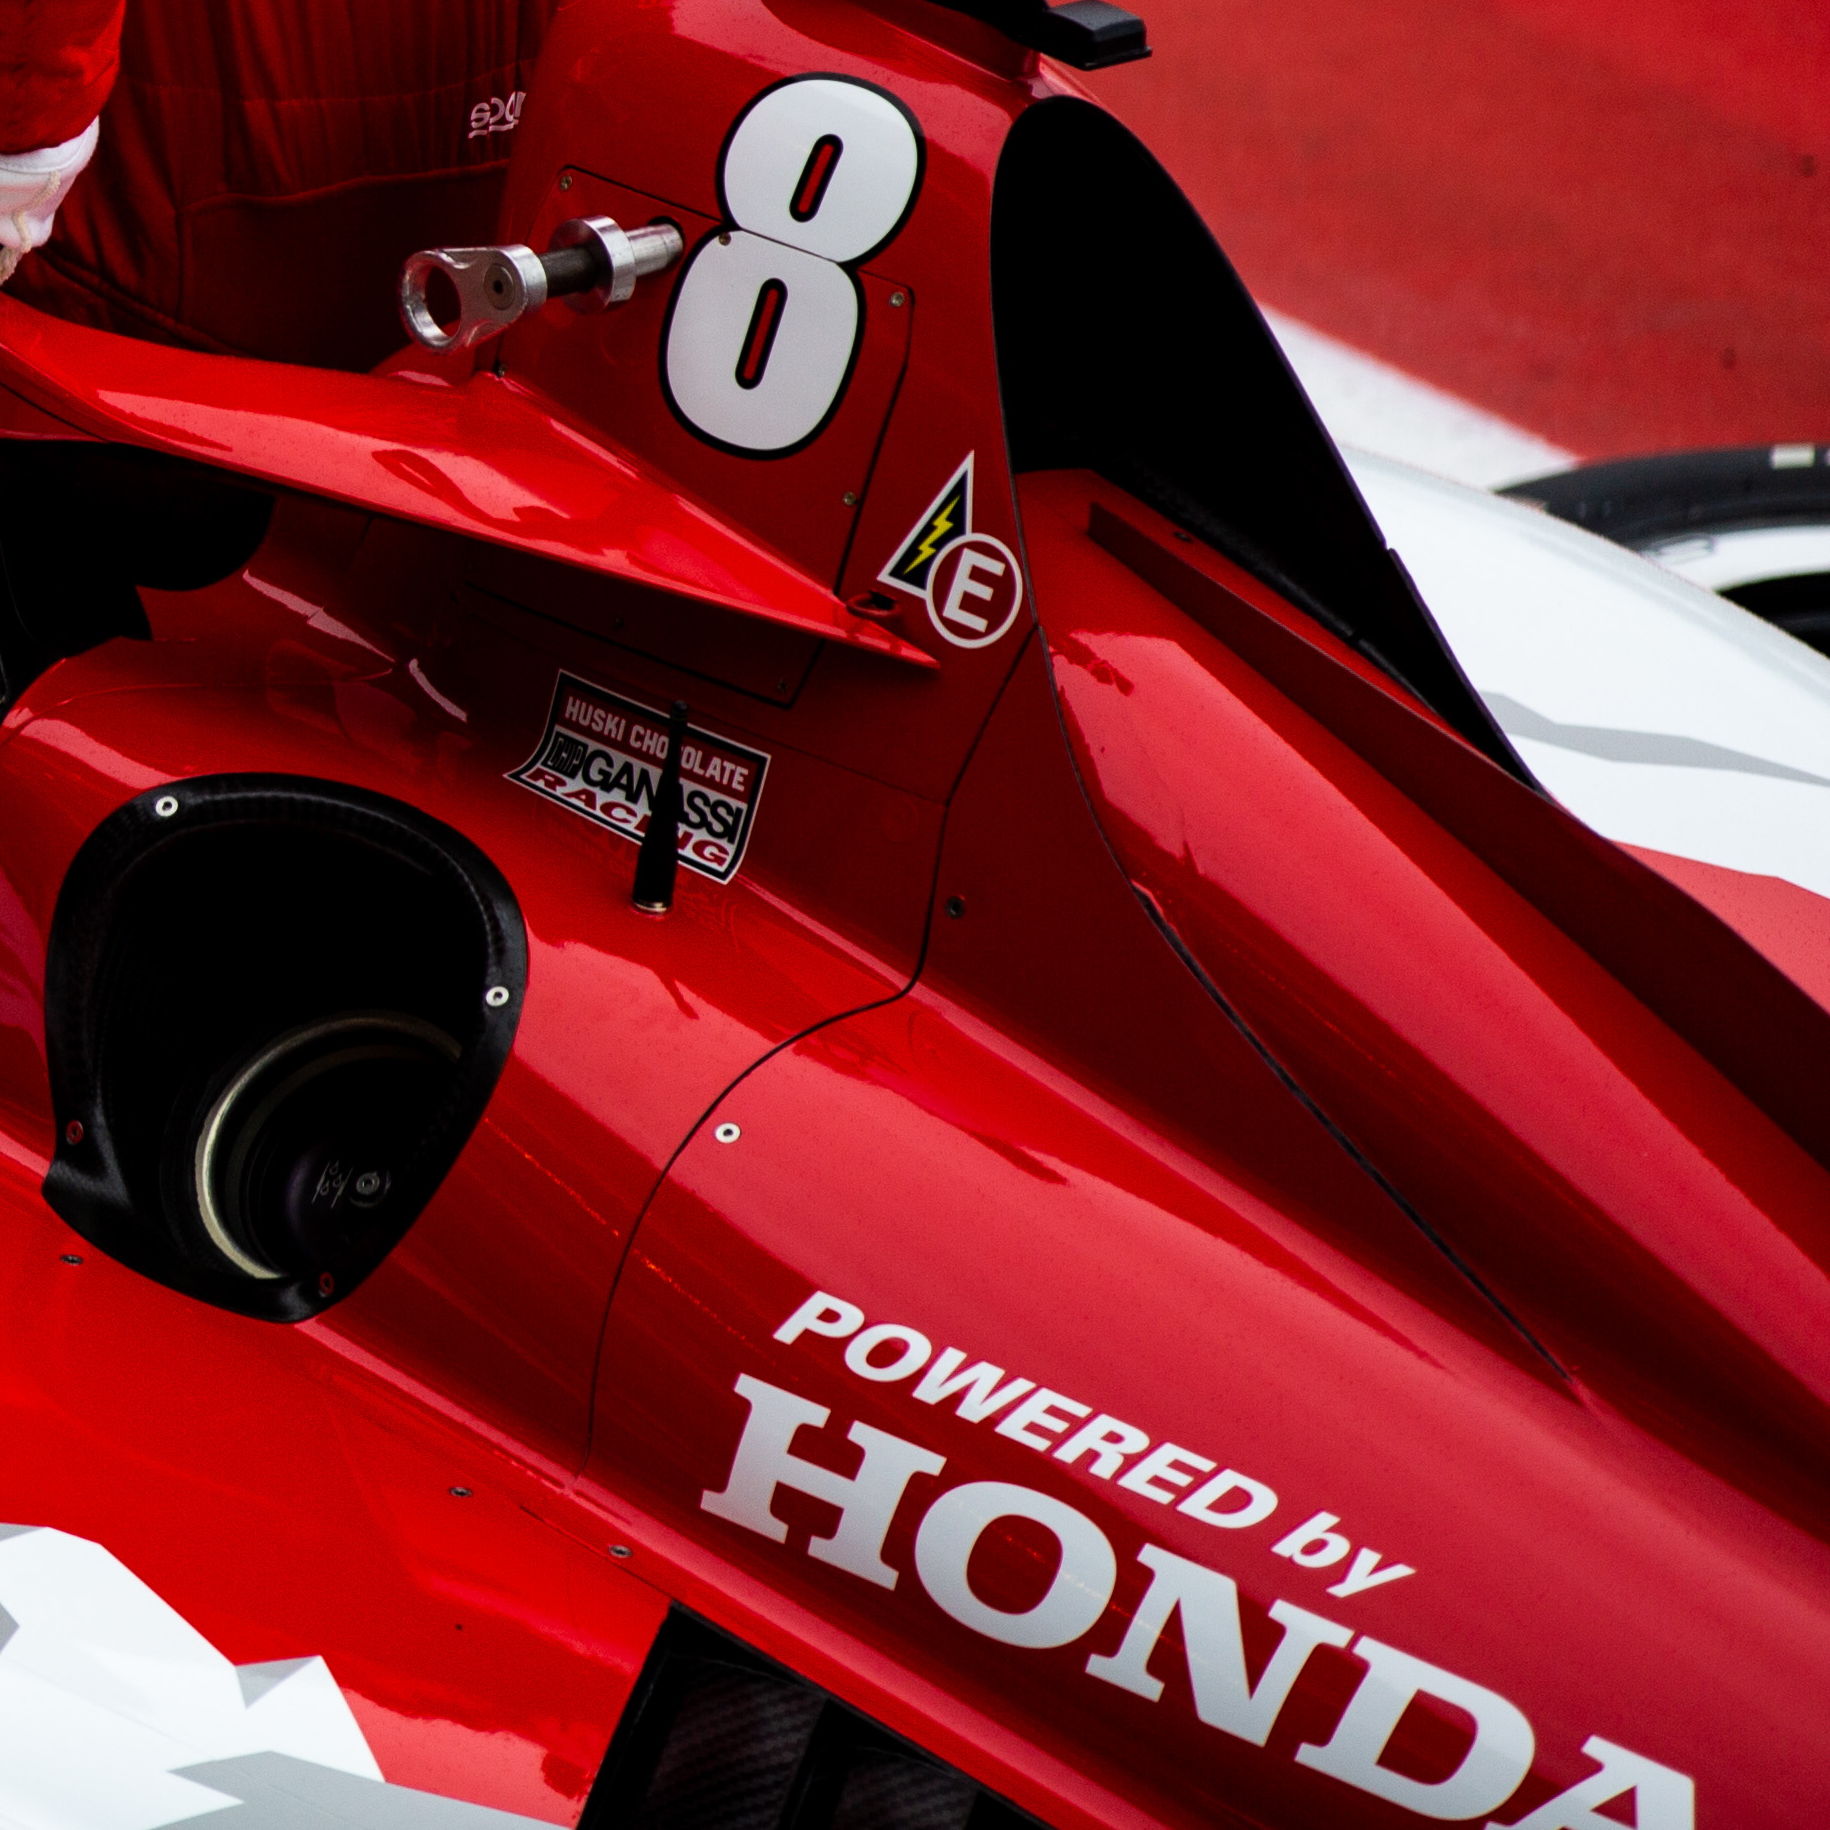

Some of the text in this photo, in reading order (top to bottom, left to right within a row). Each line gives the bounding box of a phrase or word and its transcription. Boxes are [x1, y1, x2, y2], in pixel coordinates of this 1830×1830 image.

[659, 71, 928, 461] 8
[942, 547, 1007, 633] E
[548, 736, 586, 778] CHIP
[564, 695, 750, 793] HUSKI CHOOLATE
[771, 1290, 1417, 1598] POWERED by
